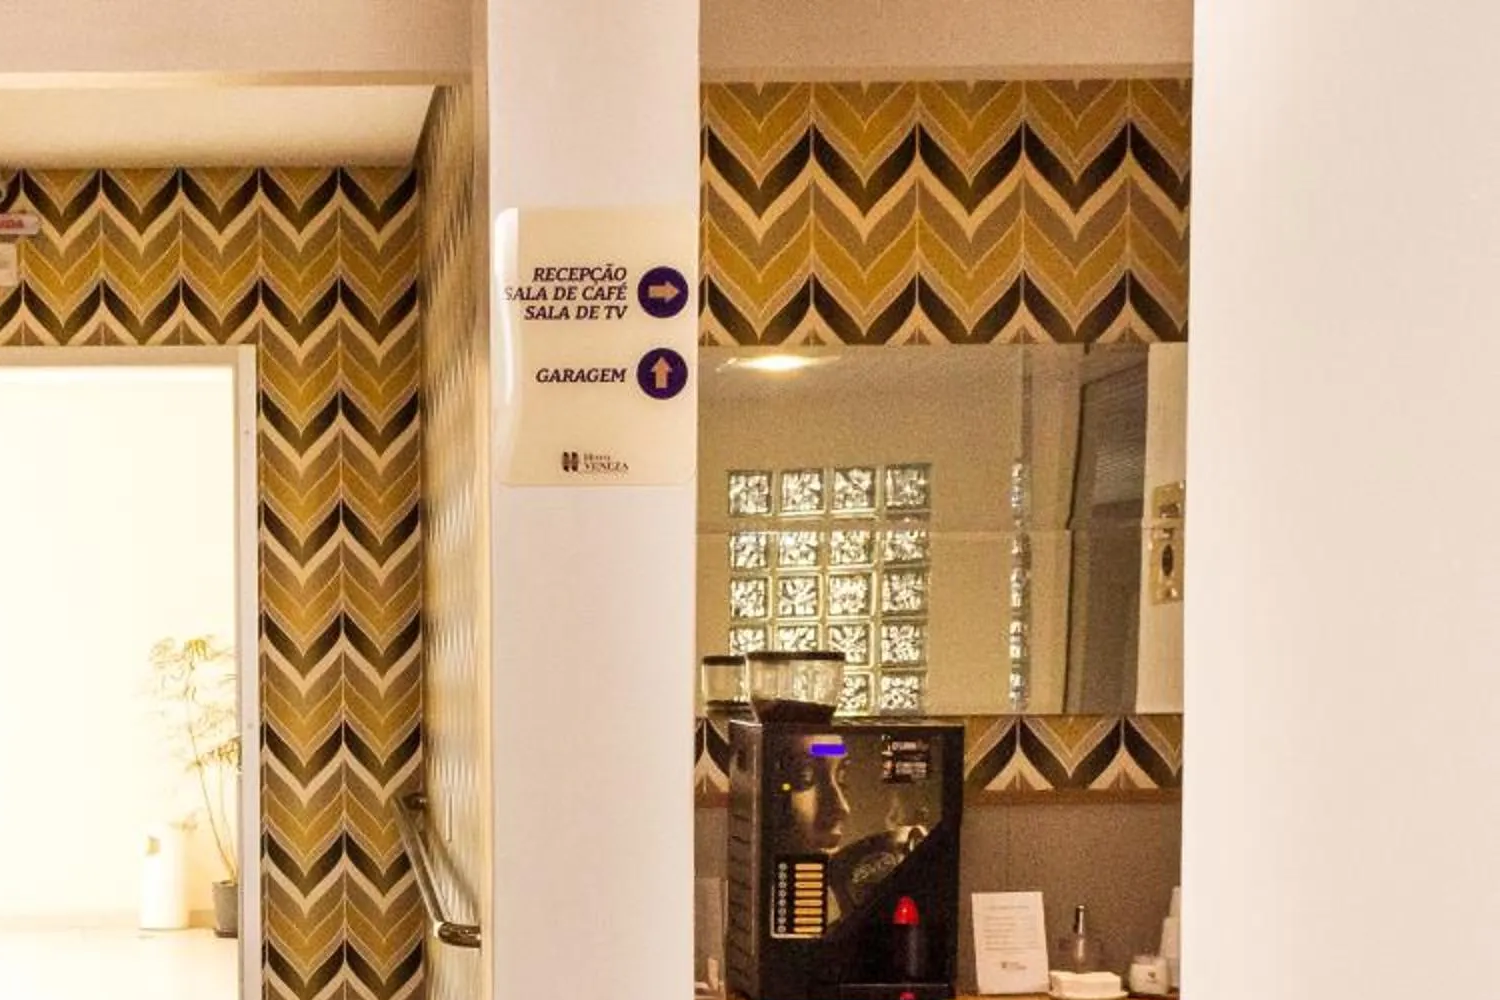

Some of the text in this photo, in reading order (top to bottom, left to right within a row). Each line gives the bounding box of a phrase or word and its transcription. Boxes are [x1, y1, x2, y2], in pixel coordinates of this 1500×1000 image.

[532, 263, 627, 285] RECEPÇÃO
[504, 282, 628, 301] SALA DE CAFÉ
[524, 305, 628, 320] SALA DE TV
[535, 367, 627, 383] GARAGEM
